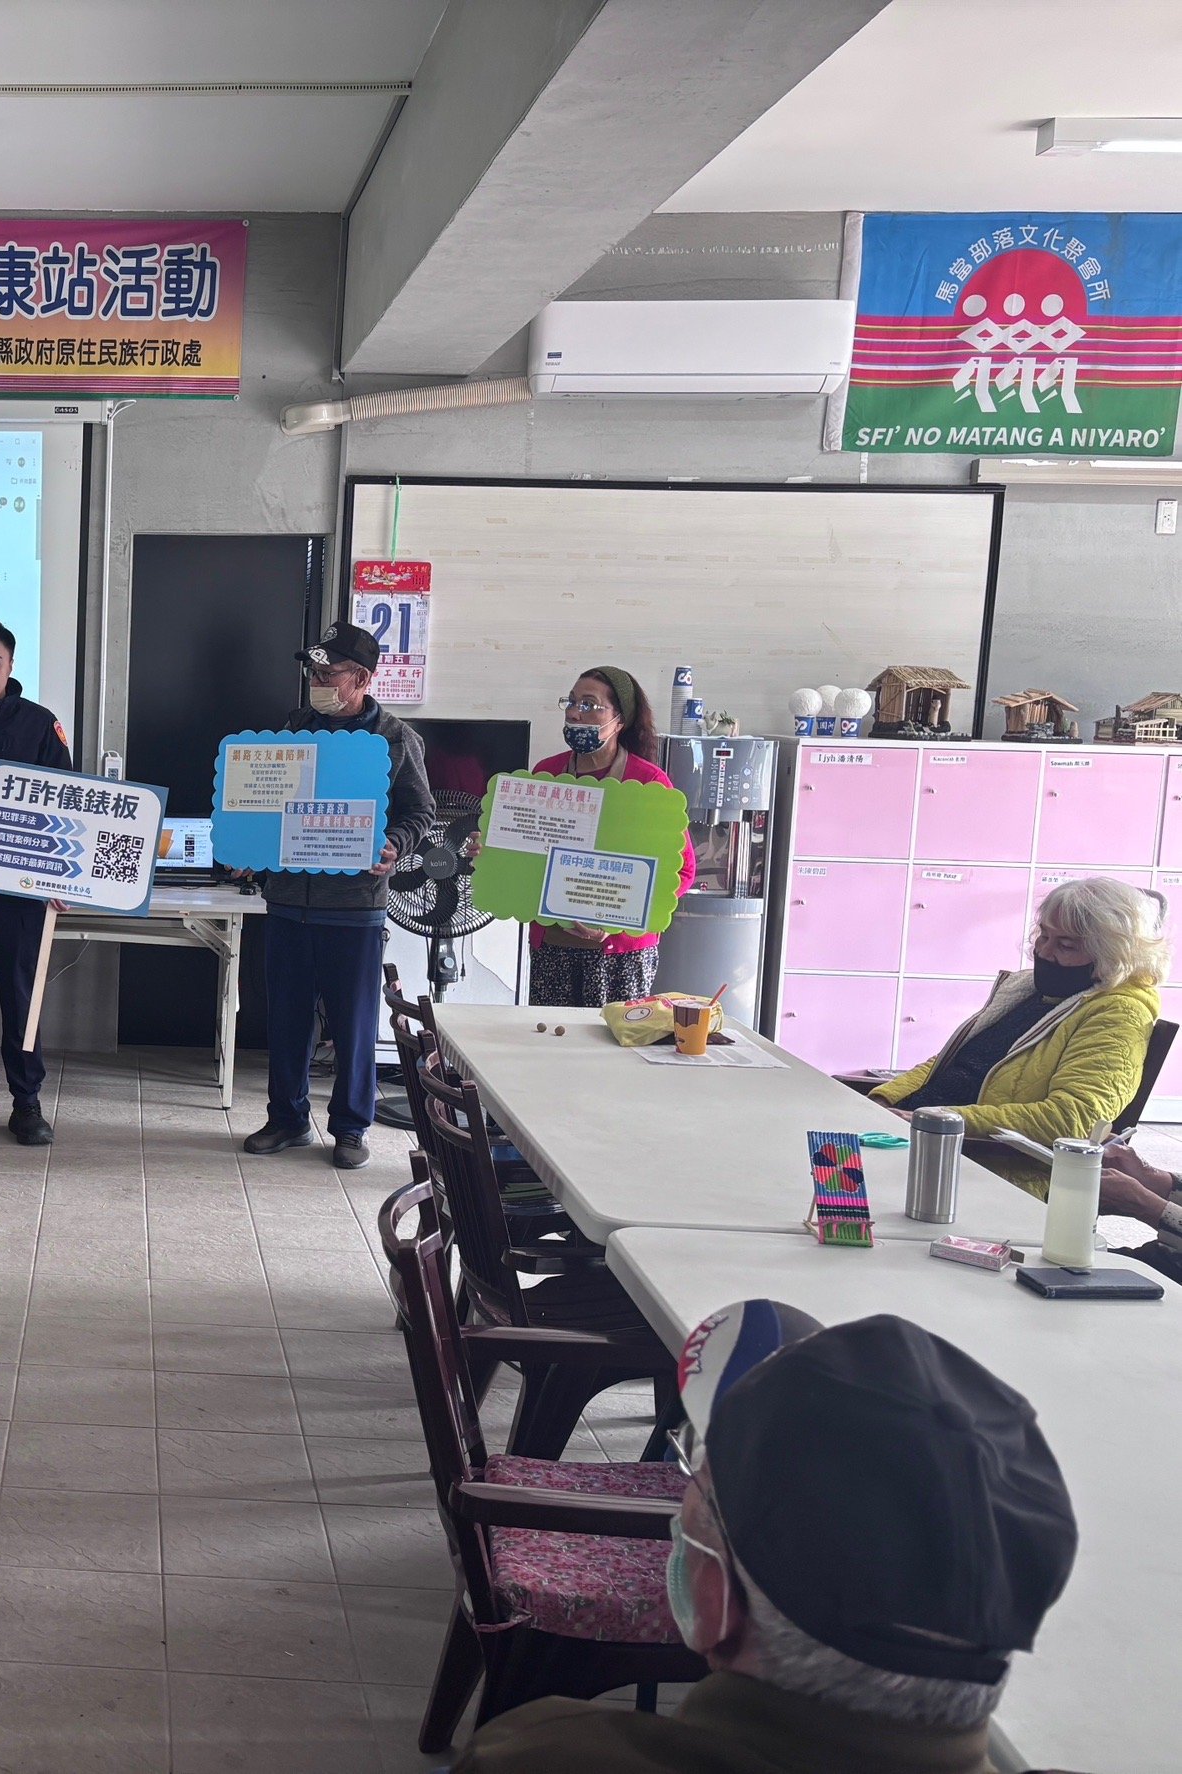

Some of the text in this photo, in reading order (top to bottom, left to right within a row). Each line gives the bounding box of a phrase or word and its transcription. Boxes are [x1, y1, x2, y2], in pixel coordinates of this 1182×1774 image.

[935, 224, 1111, 303] 馬當部落文化聚會所
[905, 428, 942, 446] NO
[946, 427, 1043, 446] MATANG
[1048, 428, 1064, 446] A
[371, 602, 411, 653] 21
[2, 774, 140, 821] 打詐儀錶板
[287, 802, 345, 815] 假投資套路深
[560, 854, 634, 875] 假中獎 真騙局
